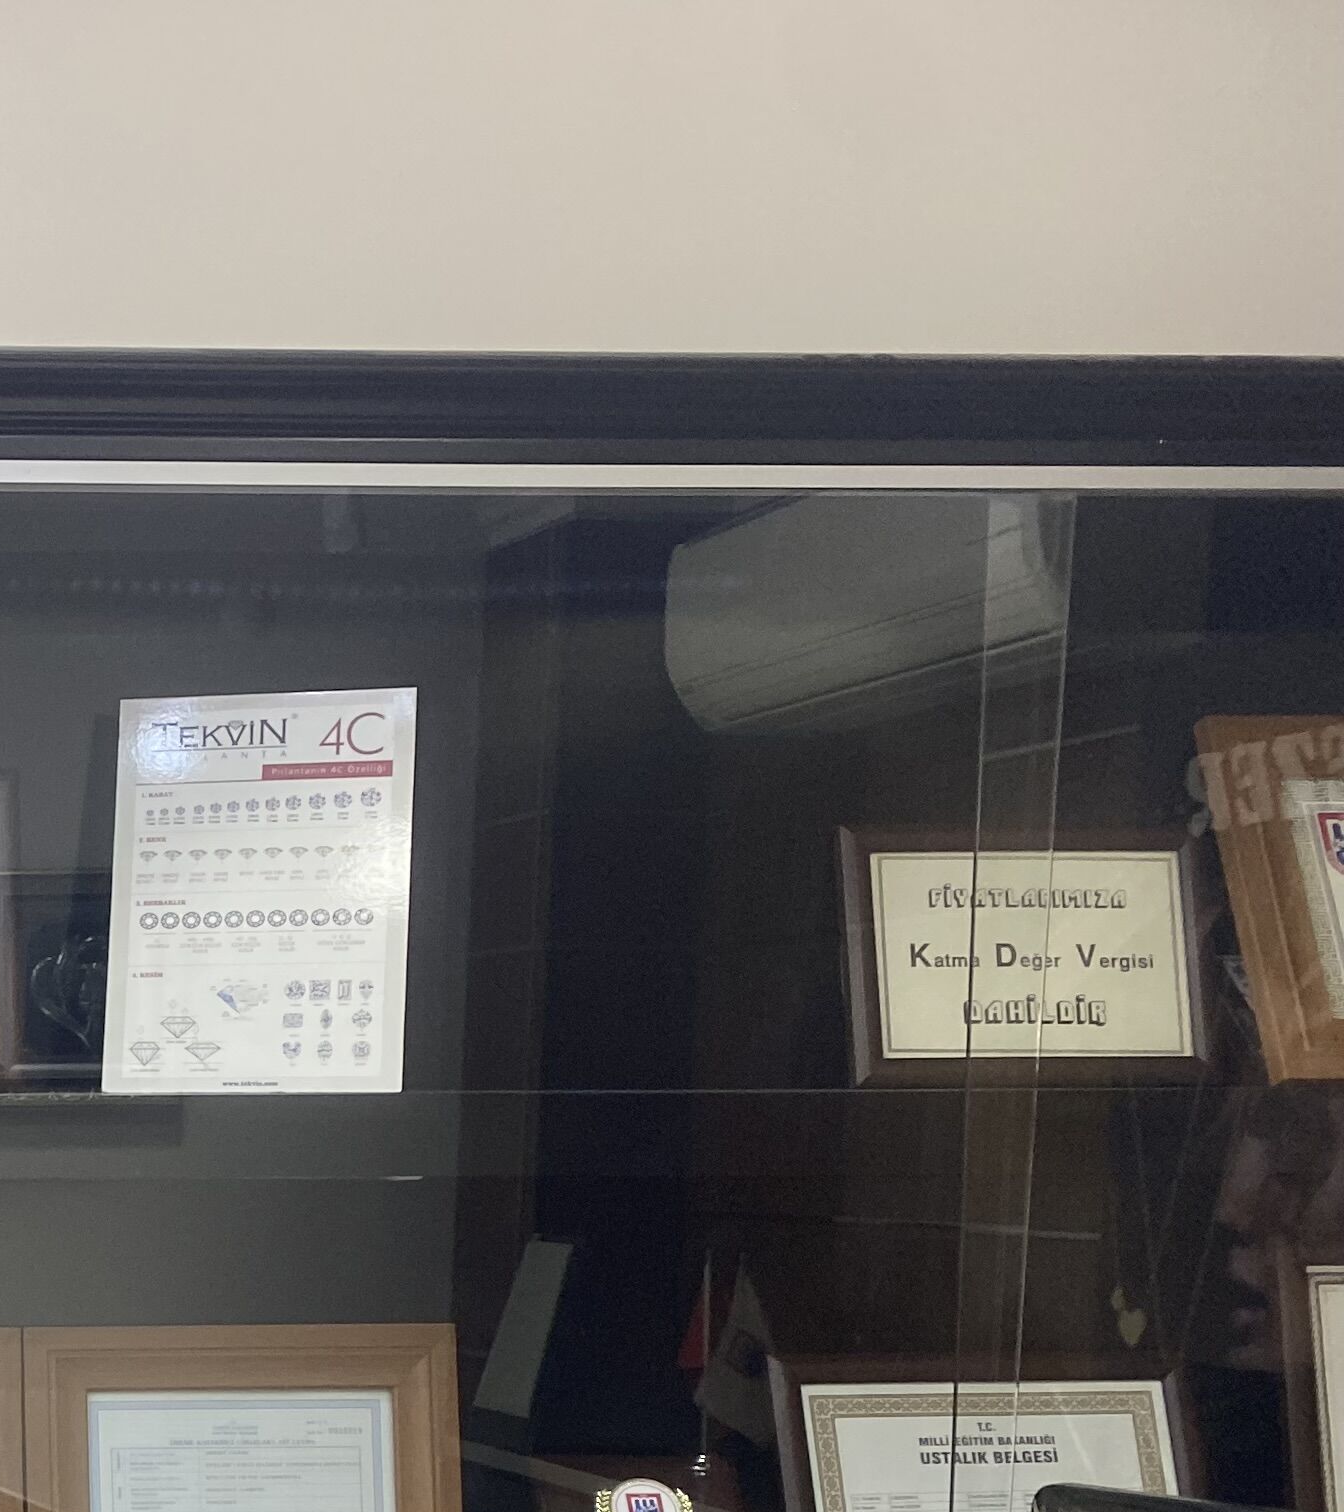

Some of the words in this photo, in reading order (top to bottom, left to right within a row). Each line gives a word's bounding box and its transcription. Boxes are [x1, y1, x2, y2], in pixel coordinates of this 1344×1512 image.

[318, 711, 386, 756] 4C
[909, 942, 981, 968] Katma
[995, 942, 1062, 971] Değer
[1075, 943, 1154, 972] Vergisi
[963, 994, 1107, 1026] DAHİLDİR
[919, 1451, 989, 1465] USTALIK
[993, 1447, 1059, 1464] BELGESİ
